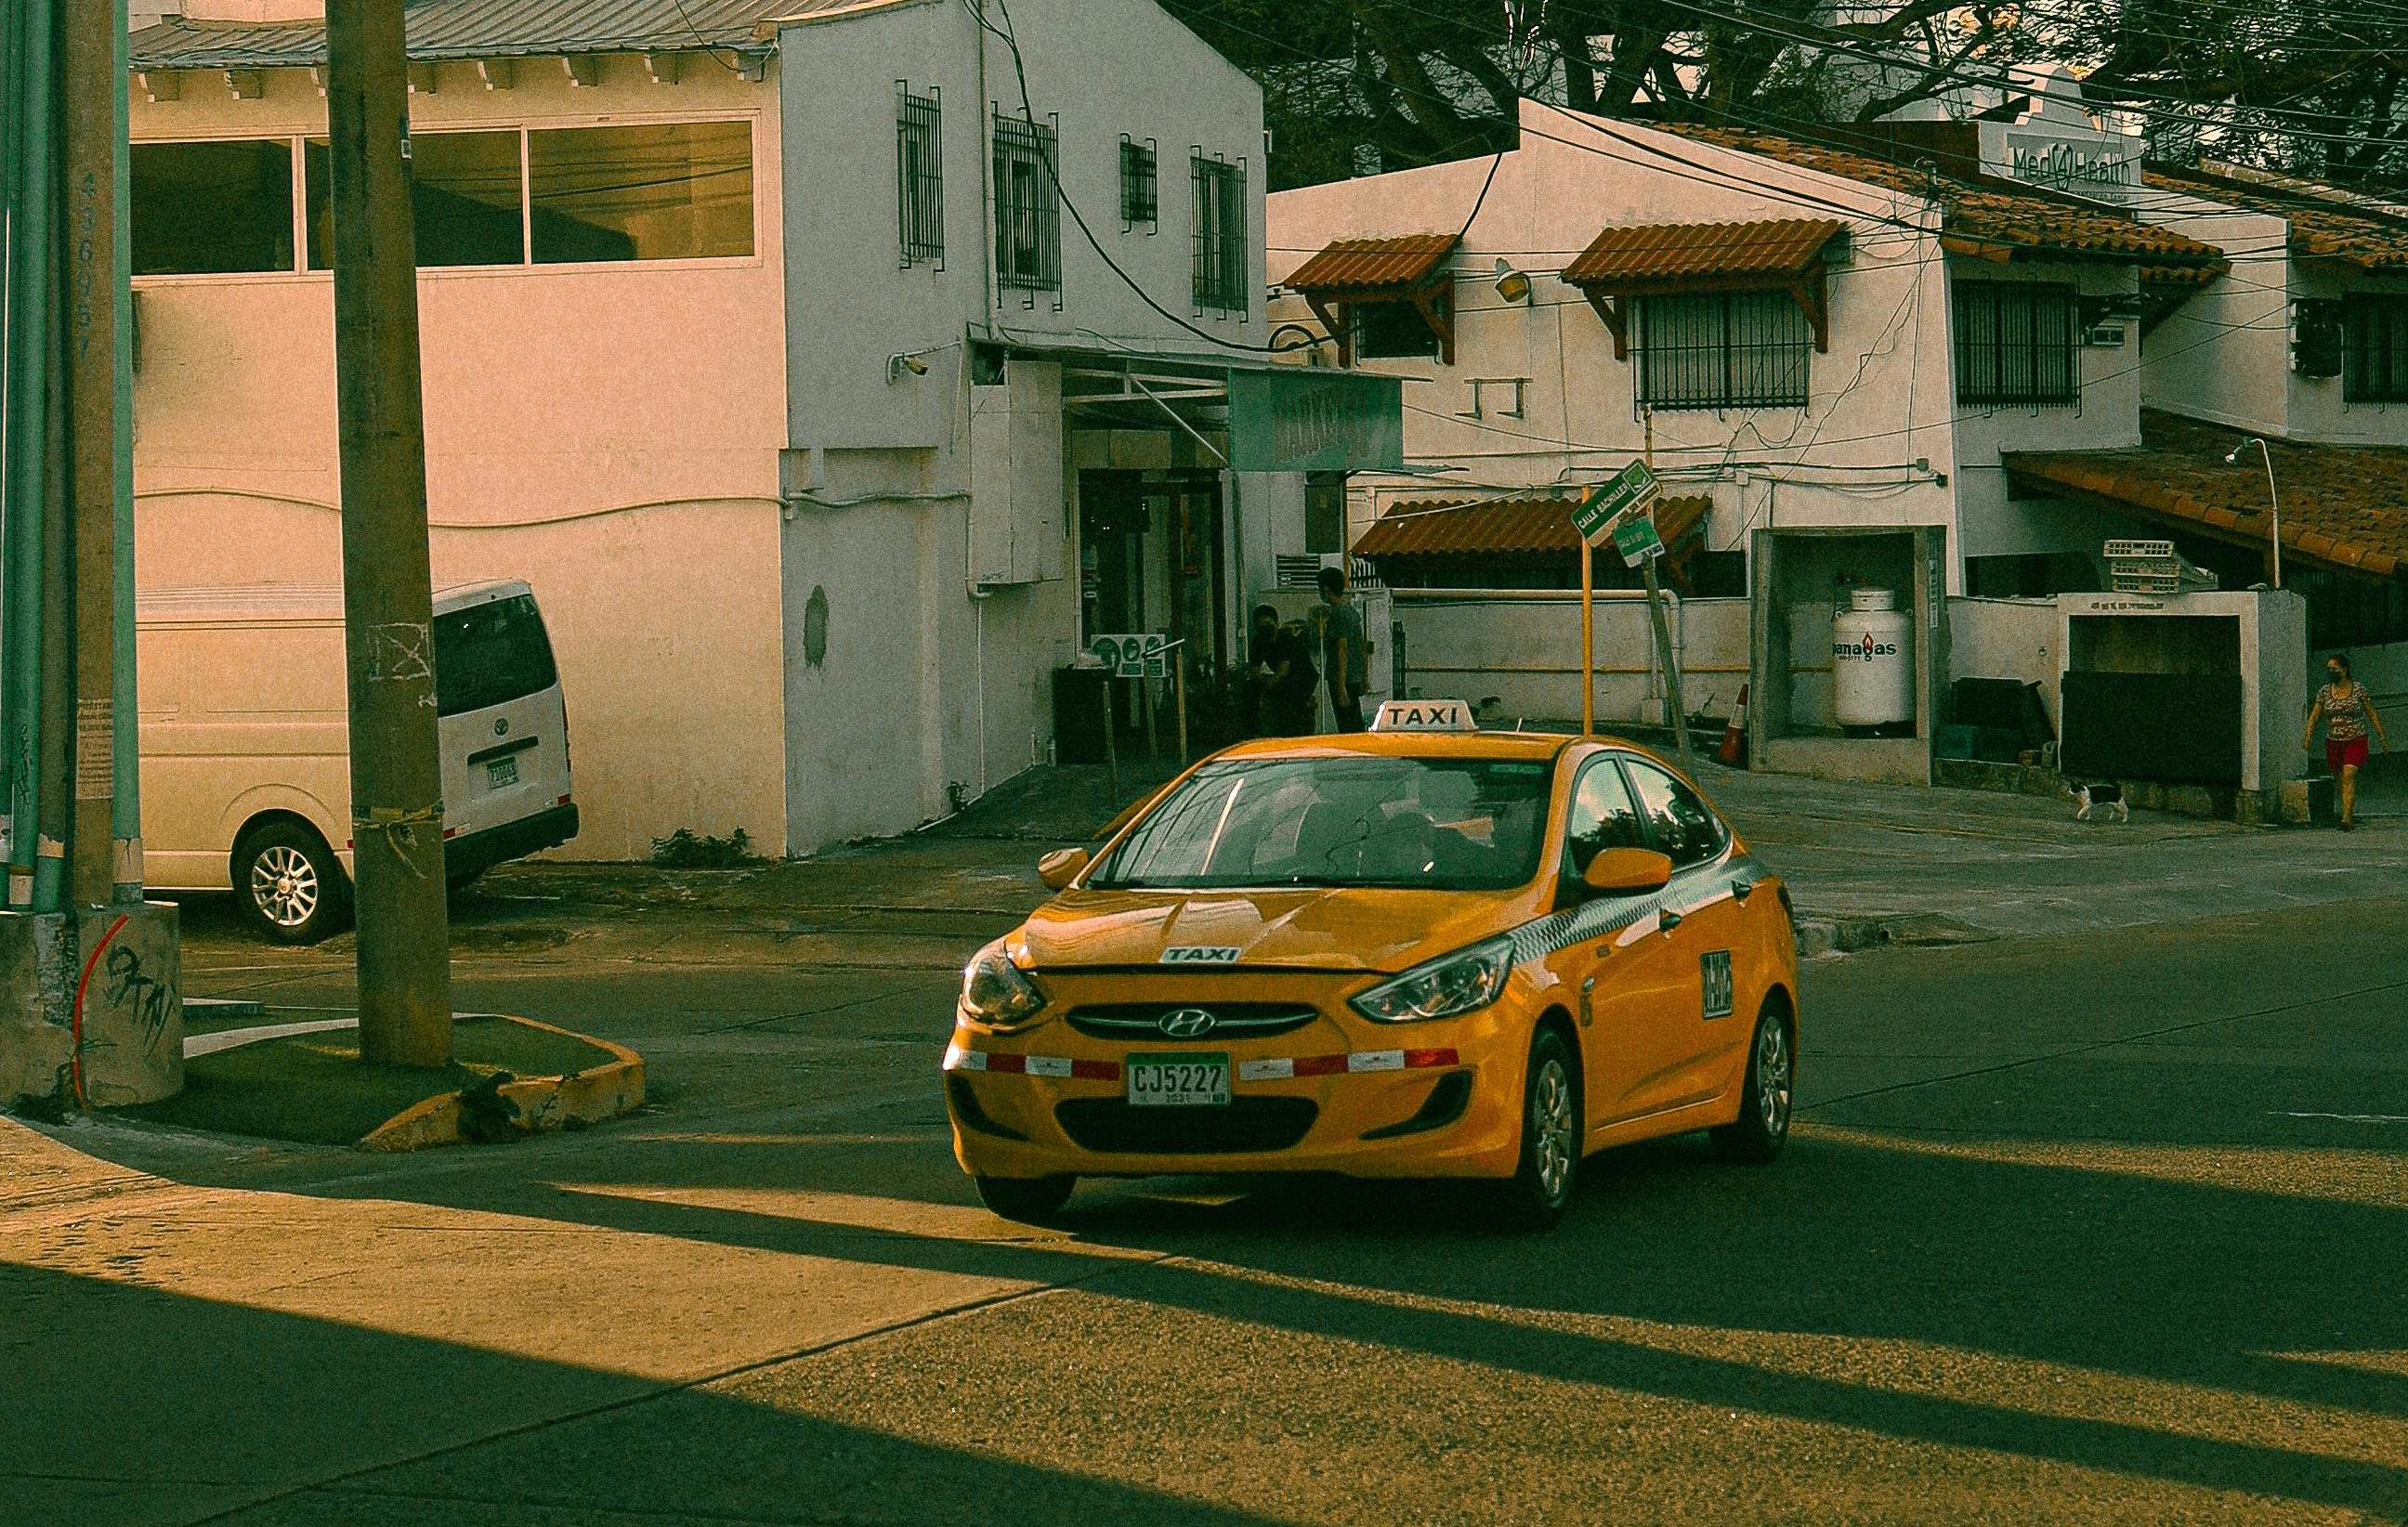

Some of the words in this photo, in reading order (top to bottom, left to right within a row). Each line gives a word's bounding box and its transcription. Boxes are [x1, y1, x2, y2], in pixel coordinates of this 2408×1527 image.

[1577, 509, 1598, 529] CALLE
[1387, 707, 1458, 724] TAXI
[1169, 948, 1239, 961] TAXI
[1134, 1064, 1222, 1093] CJ5227
